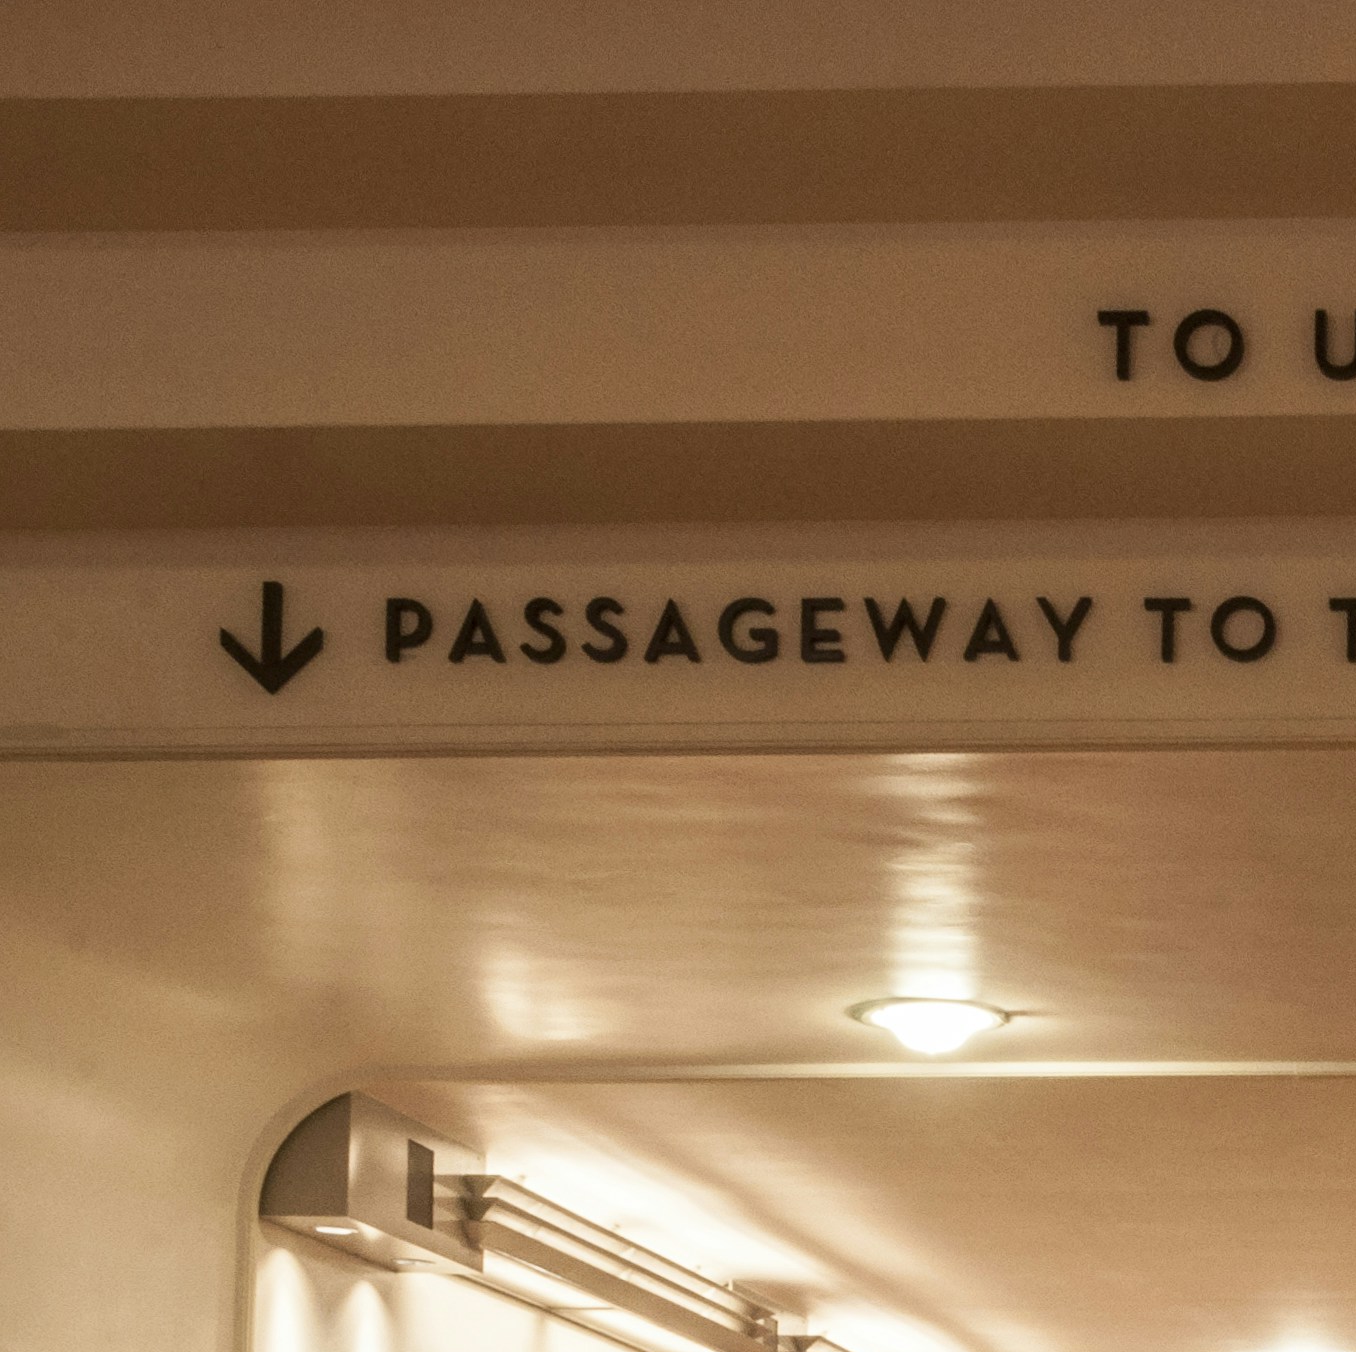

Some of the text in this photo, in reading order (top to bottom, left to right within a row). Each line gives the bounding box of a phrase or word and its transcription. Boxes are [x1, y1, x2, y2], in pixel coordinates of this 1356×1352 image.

[1097, 308, 1250, 383] TO
[384, 596, 1094, 666] PASSAGEWAY
[1143, 595, 1281, 664] TO
